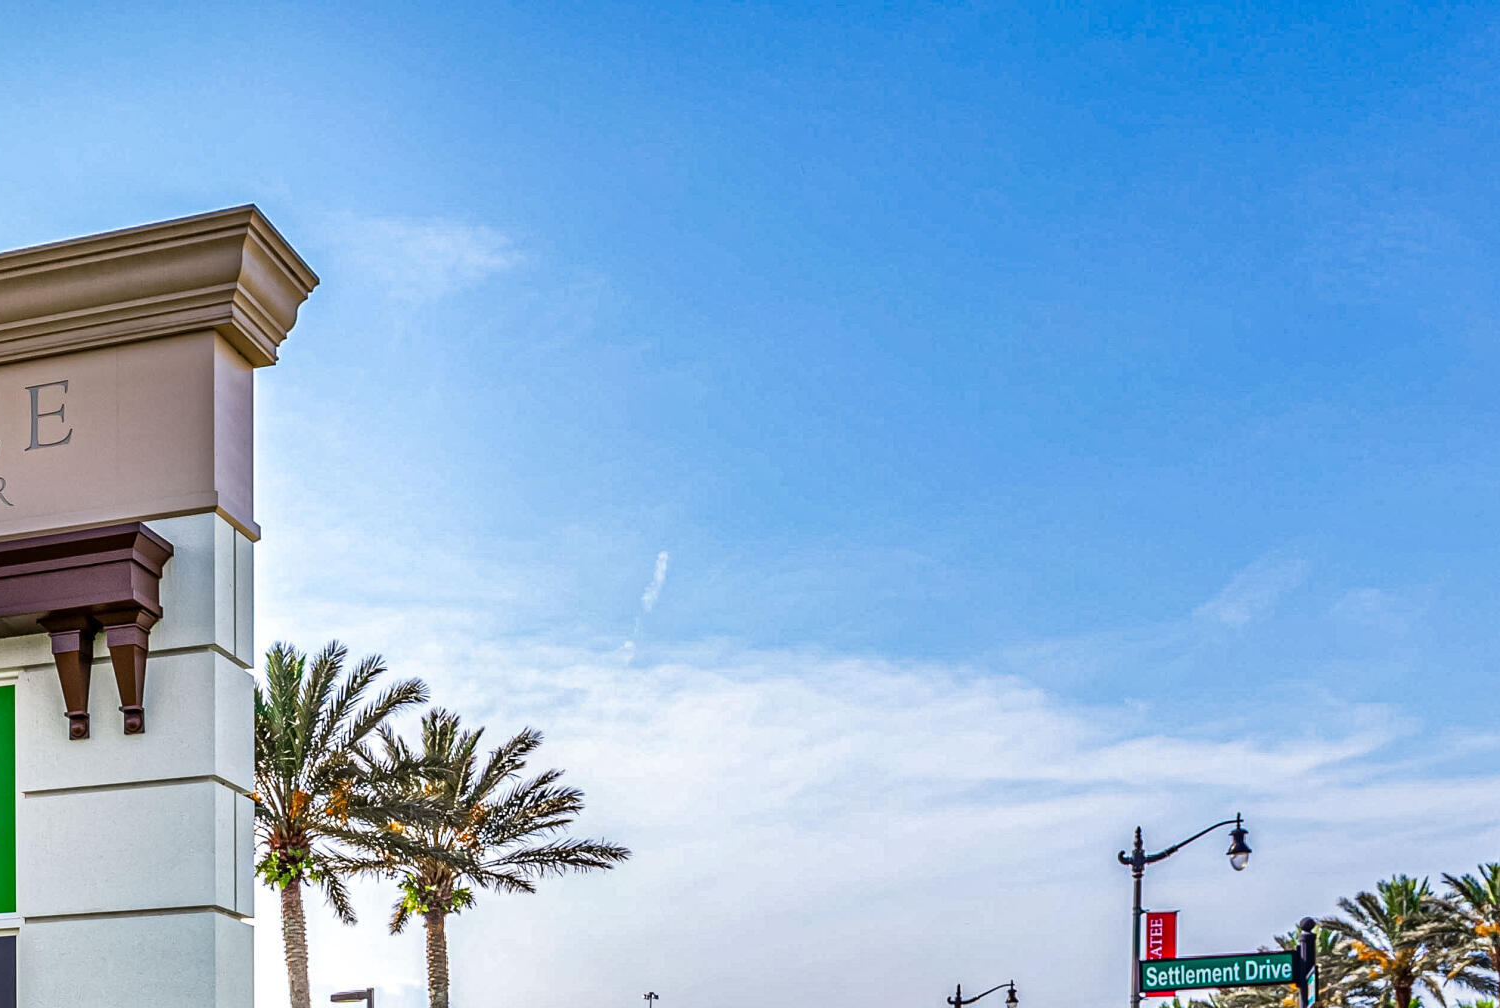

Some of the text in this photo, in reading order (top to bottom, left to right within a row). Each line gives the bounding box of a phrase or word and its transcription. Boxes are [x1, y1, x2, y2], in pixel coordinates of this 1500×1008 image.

[1149, 918, 1163, 960] ATEE
[1146, 960, 1293, 987] Settlement Drive
